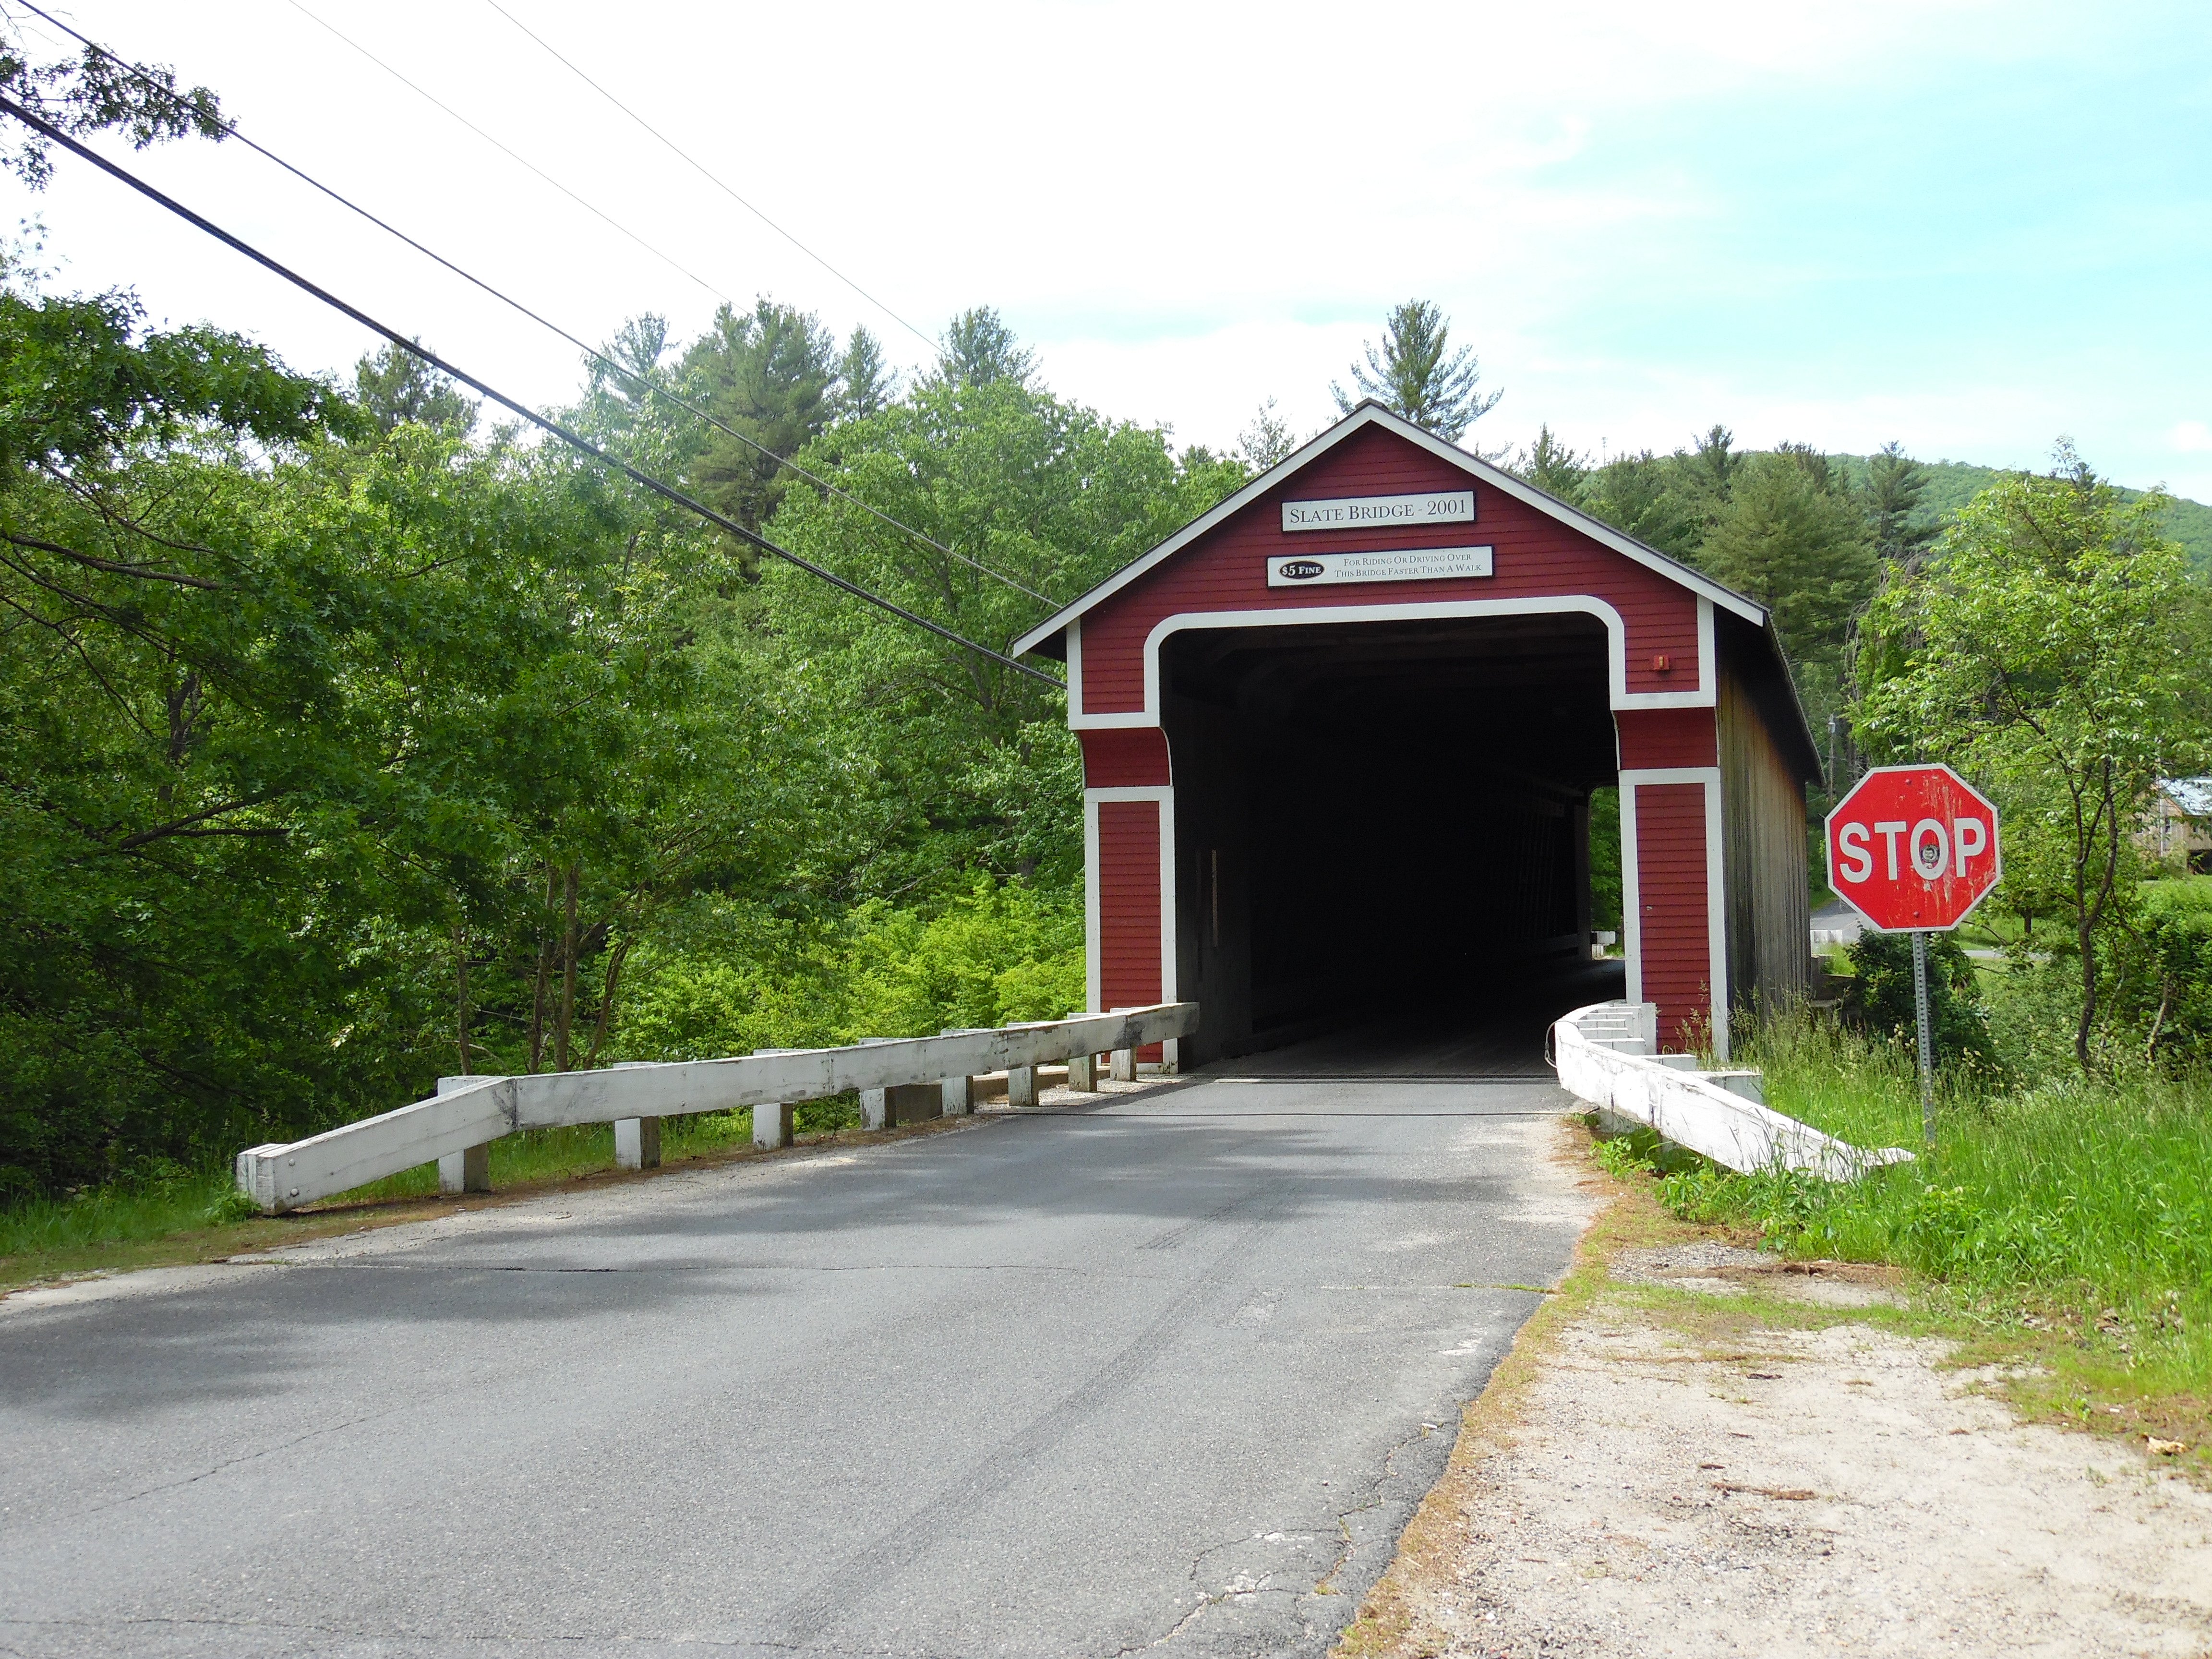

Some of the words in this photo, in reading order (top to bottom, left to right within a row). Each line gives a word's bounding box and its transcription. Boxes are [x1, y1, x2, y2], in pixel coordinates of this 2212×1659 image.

[1290, 508, 1344, 524] SLATE
[1348, 504, 1415, 520] BRIDGE
[1427, 499, 1466, 516] 2001
[1344, 558, 1361, 566] FOR
[1362, 557, 1392, 565] RIDING
[1409, 554, 1445, 563] DRIVING
[1447, 553, 1471, 561] OVER
[1282, 565, 1296, 576] $5
[1298, 566, 1322, 575] FINE
[1356, 568, 1386, 577] BRIDGE
[1388, 567, 1419, 575] FASTER
[1839, 817, 1986, 883] STOP
